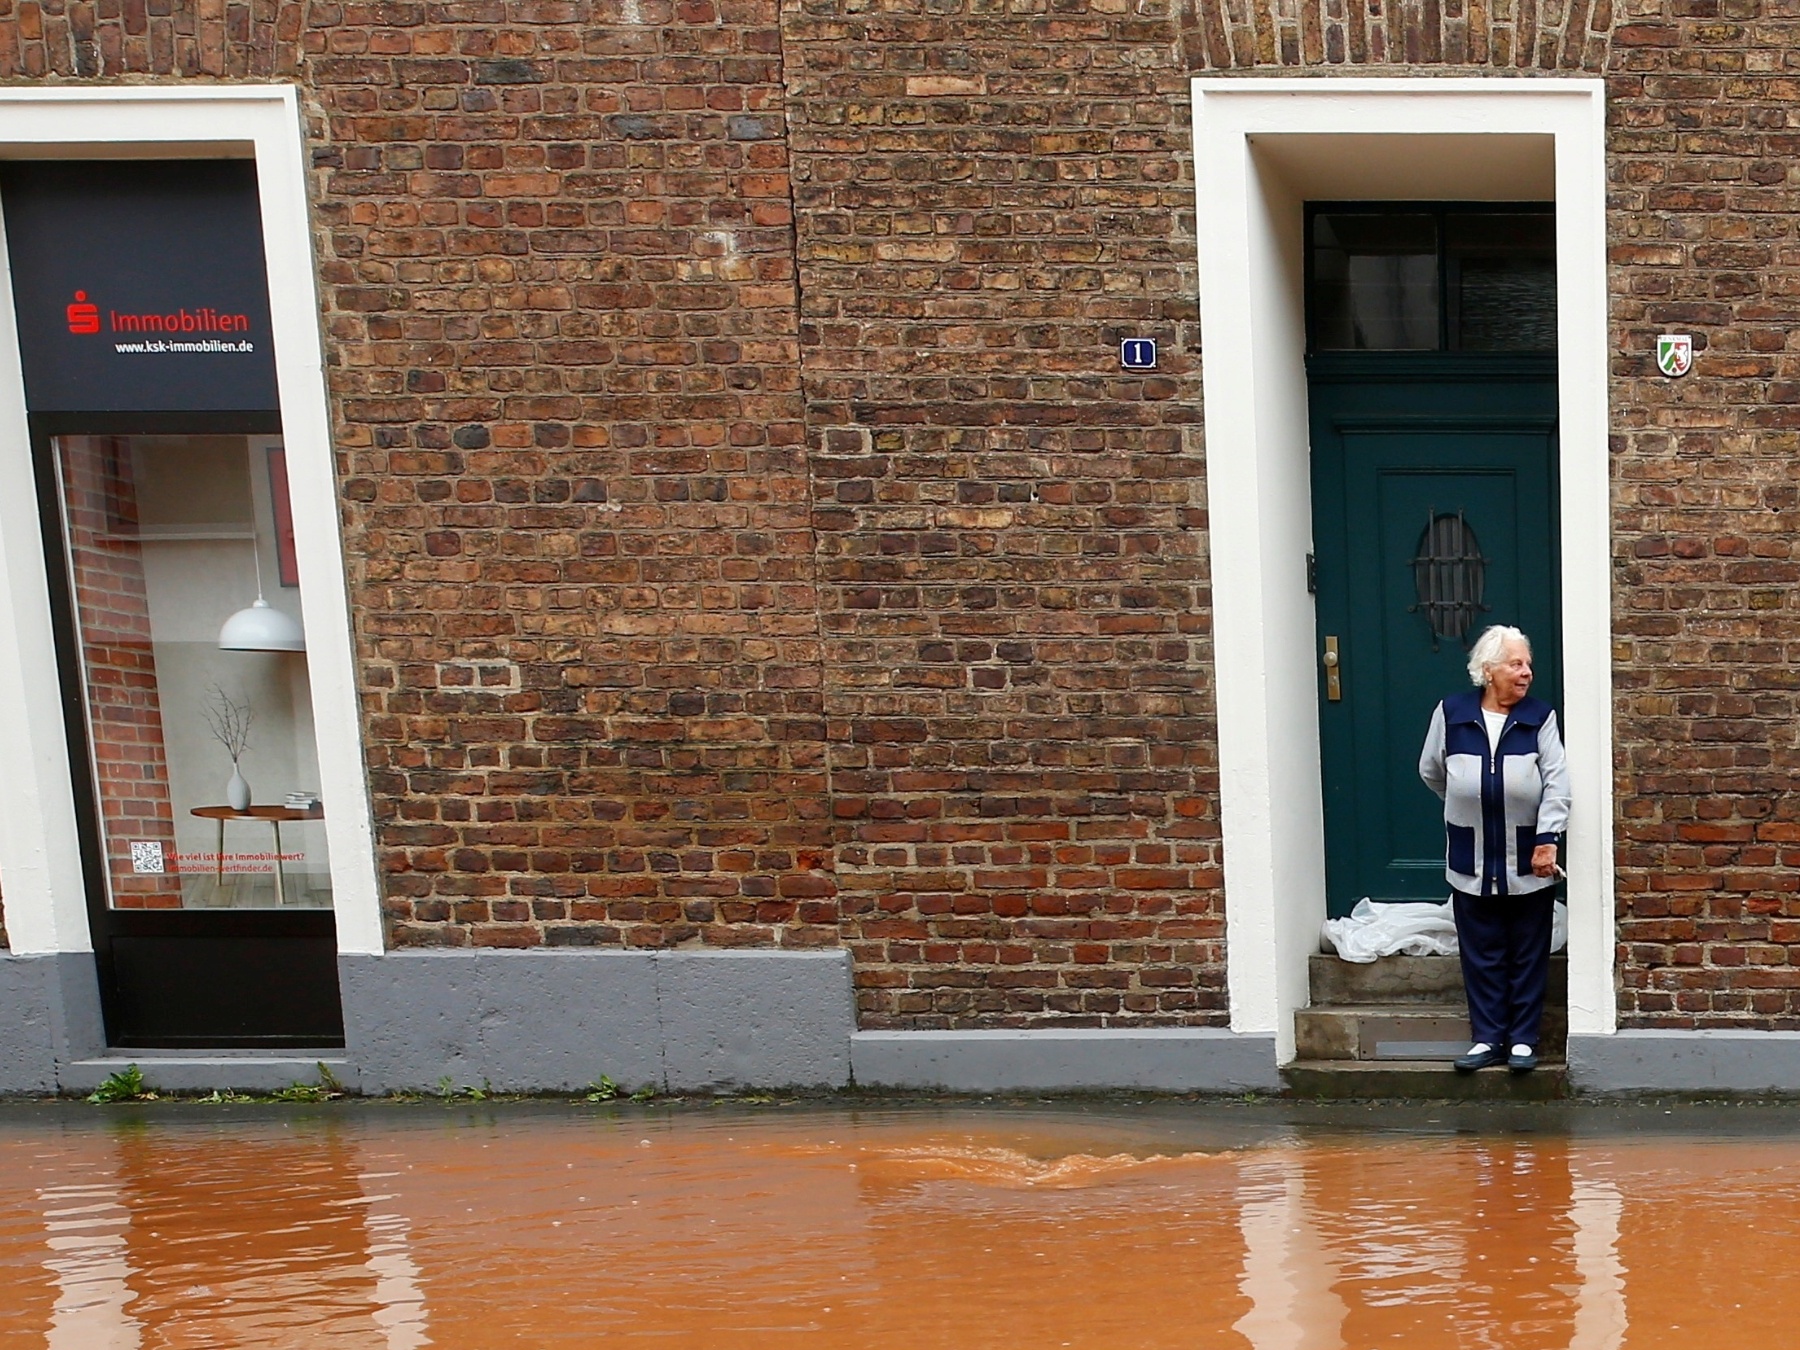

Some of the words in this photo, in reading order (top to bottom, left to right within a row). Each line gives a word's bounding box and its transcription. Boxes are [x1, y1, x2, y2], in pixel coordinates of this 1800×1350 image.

[111, 309, 248, 332] Immobilien
[115, 340, 254, 353] www.ksk-immobilien.de
[1134, 342, 1142, 363] 1
[167, 852, 184, 861] Wie
[185, 852, 201, 861] viel
[203, 852, 215, 861] ist
[236, 852, 280, 861] Immobilie
[280, 852, 305, 861] wert?
